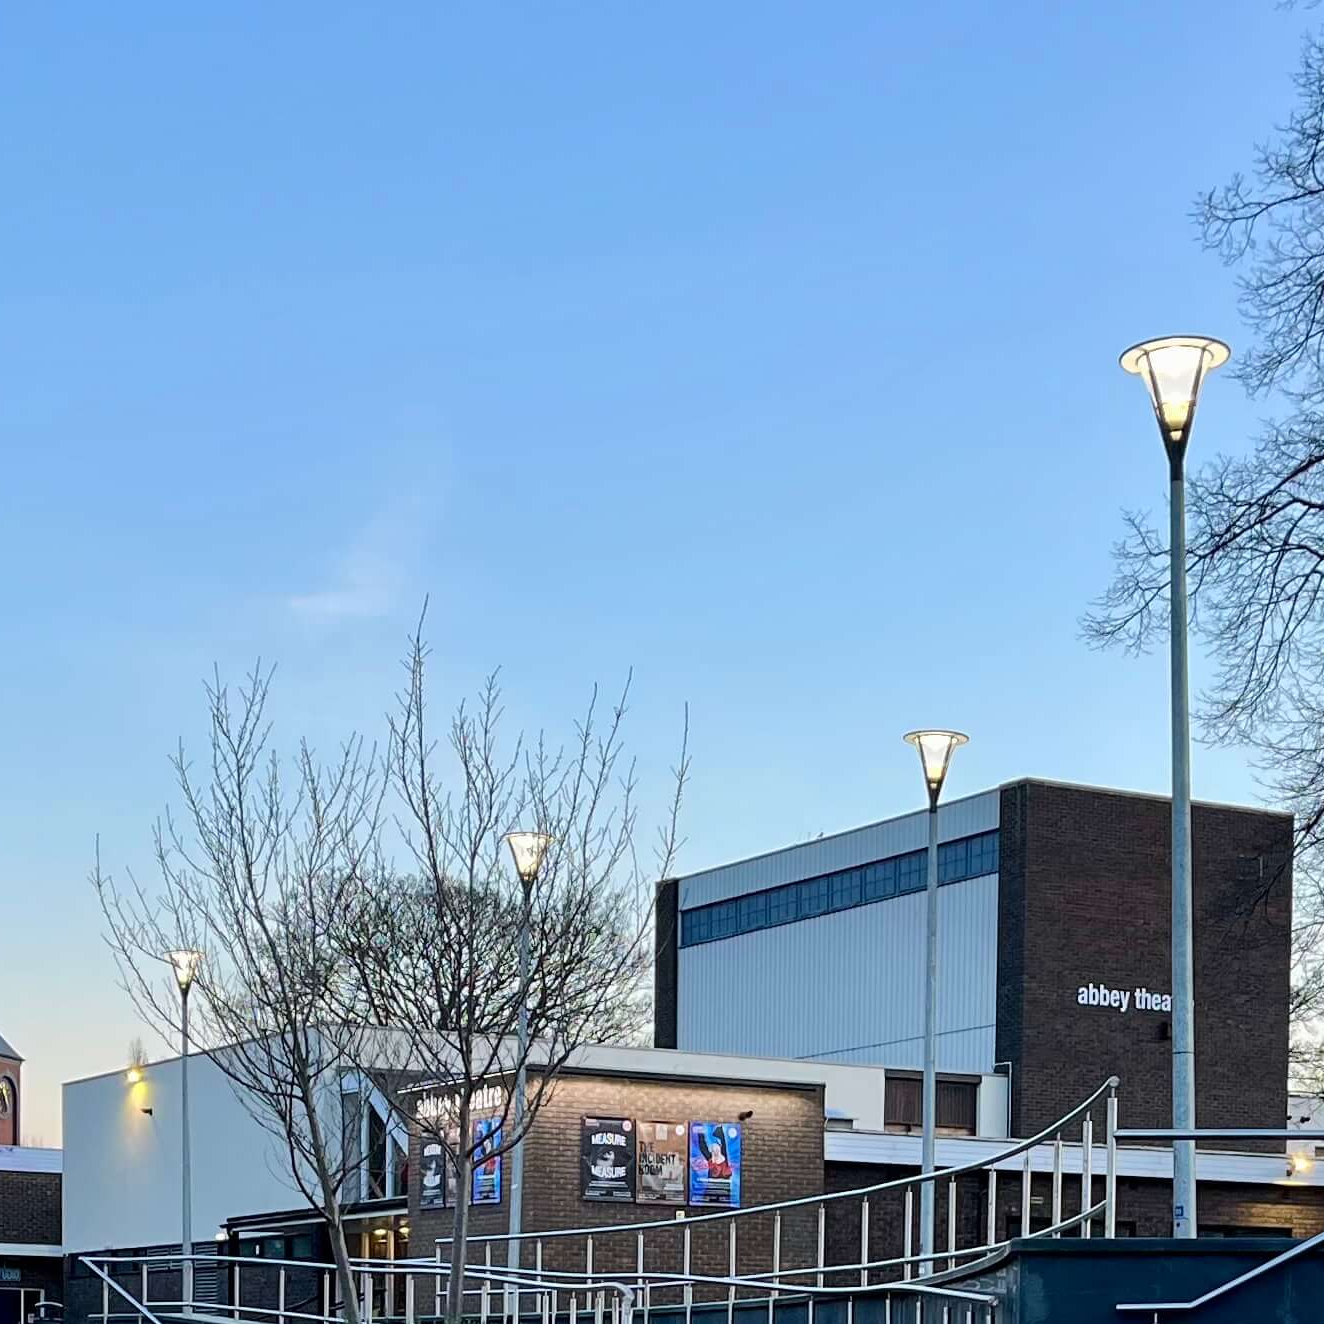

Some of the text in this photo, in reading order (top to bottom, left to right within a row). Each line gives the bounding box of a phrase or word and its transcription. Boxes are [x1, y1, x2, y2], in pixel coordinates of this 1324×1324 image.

[1077, 983, 1175, 1012] abbey thea
[591, 1132, 627, 1147] MEASURE
[638, 1152, 676, 1165] INCIDENT
[591, 1165, 627, 1178] MEASURE
